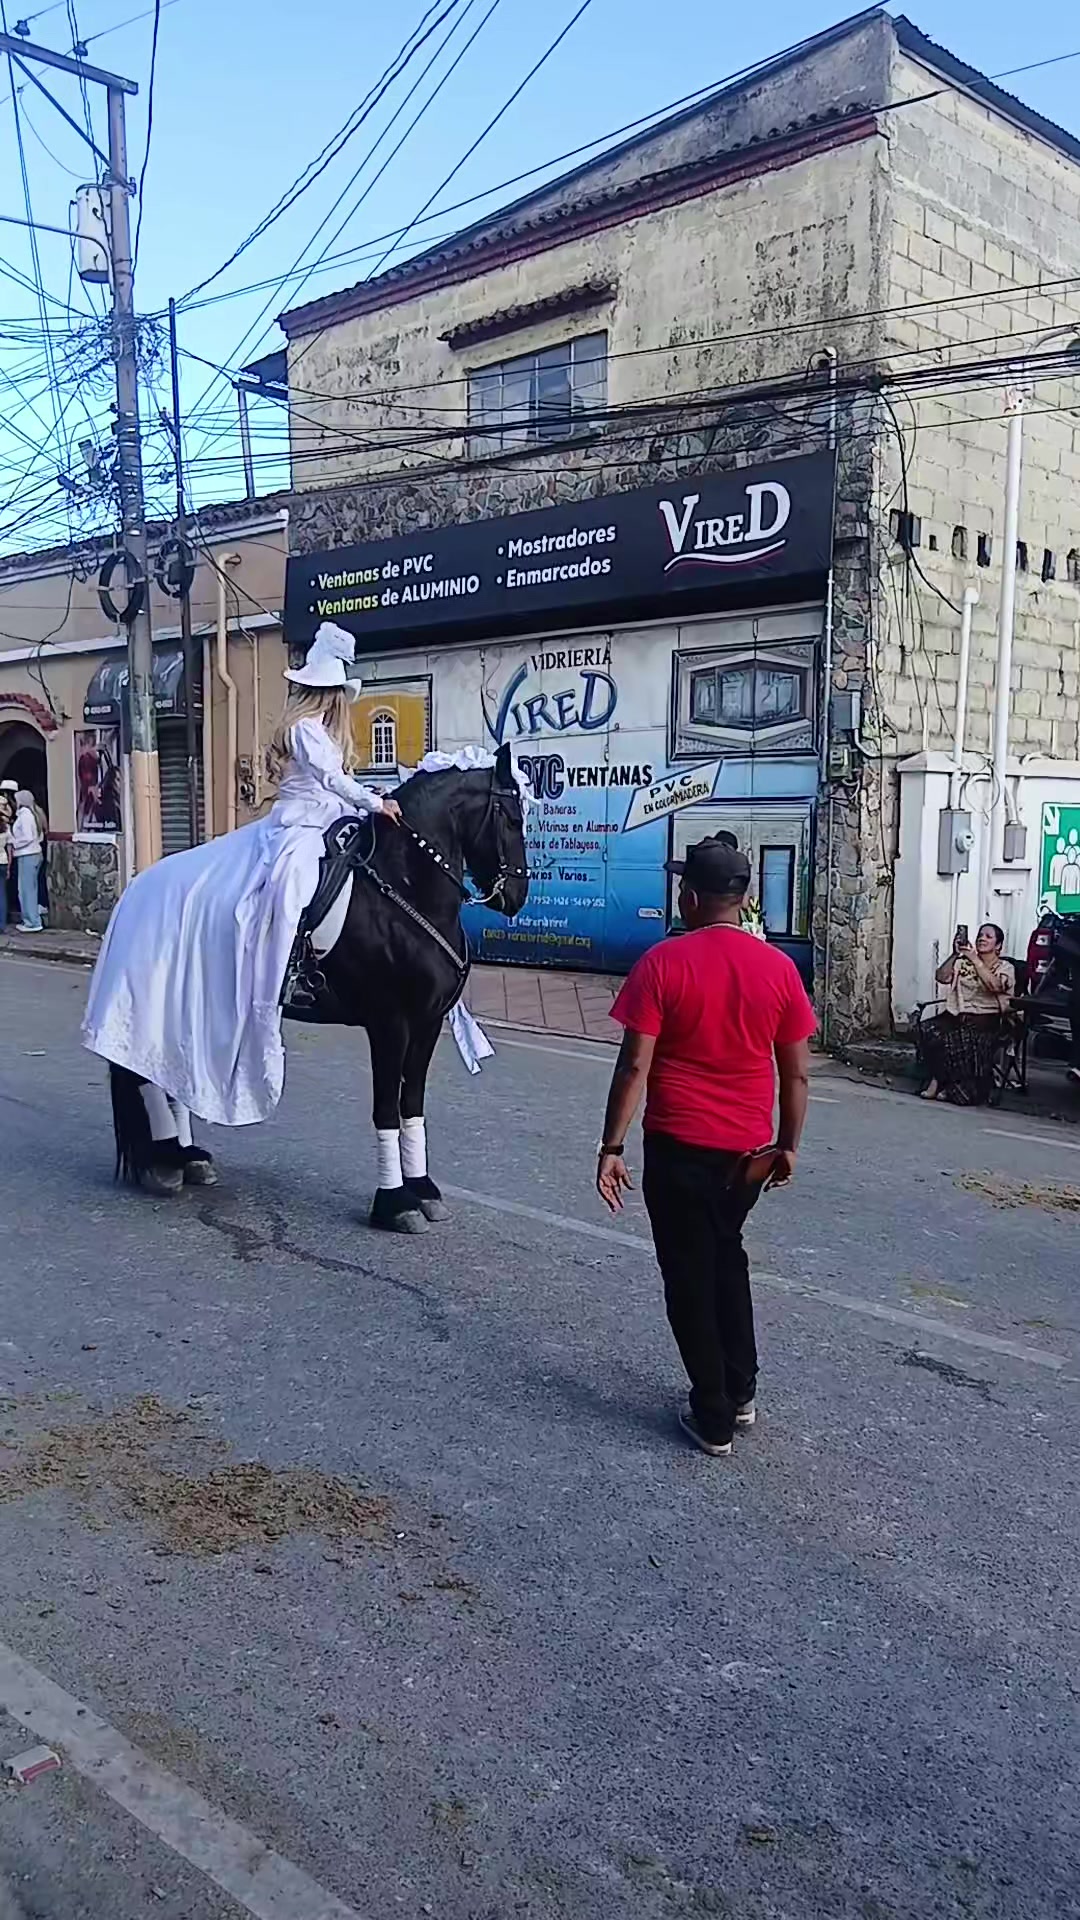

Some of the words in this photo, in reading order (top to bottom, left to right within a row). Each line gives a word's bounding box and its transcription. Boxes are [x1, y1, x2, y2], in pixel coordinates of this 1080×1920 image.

[507, 524, 616, 558] Mostradores
[318, 567, 379, 590] Ventanas
[382, 560, 400, 579] de
[403, 554, 433, 576] PVC
[506, 556, 611, 588] Enmarcados
[317, 594, 378, 616] Ventanas
[381, 587, 399, 607] de
[401, 575, 480, 604] ALUMINIO
[530, 647, 613, 671] VIDRIERIA
[567, 764, 653, 788] VENTANAS
[650, 775, 692, 798] PVC
[643, 803, 654, 814] EN
[673, 782, 709, 805] MADERA
[572, 823, 583, 832] en
[524, 838, 546, 849] echos
[549, 838, 559, 849] de
